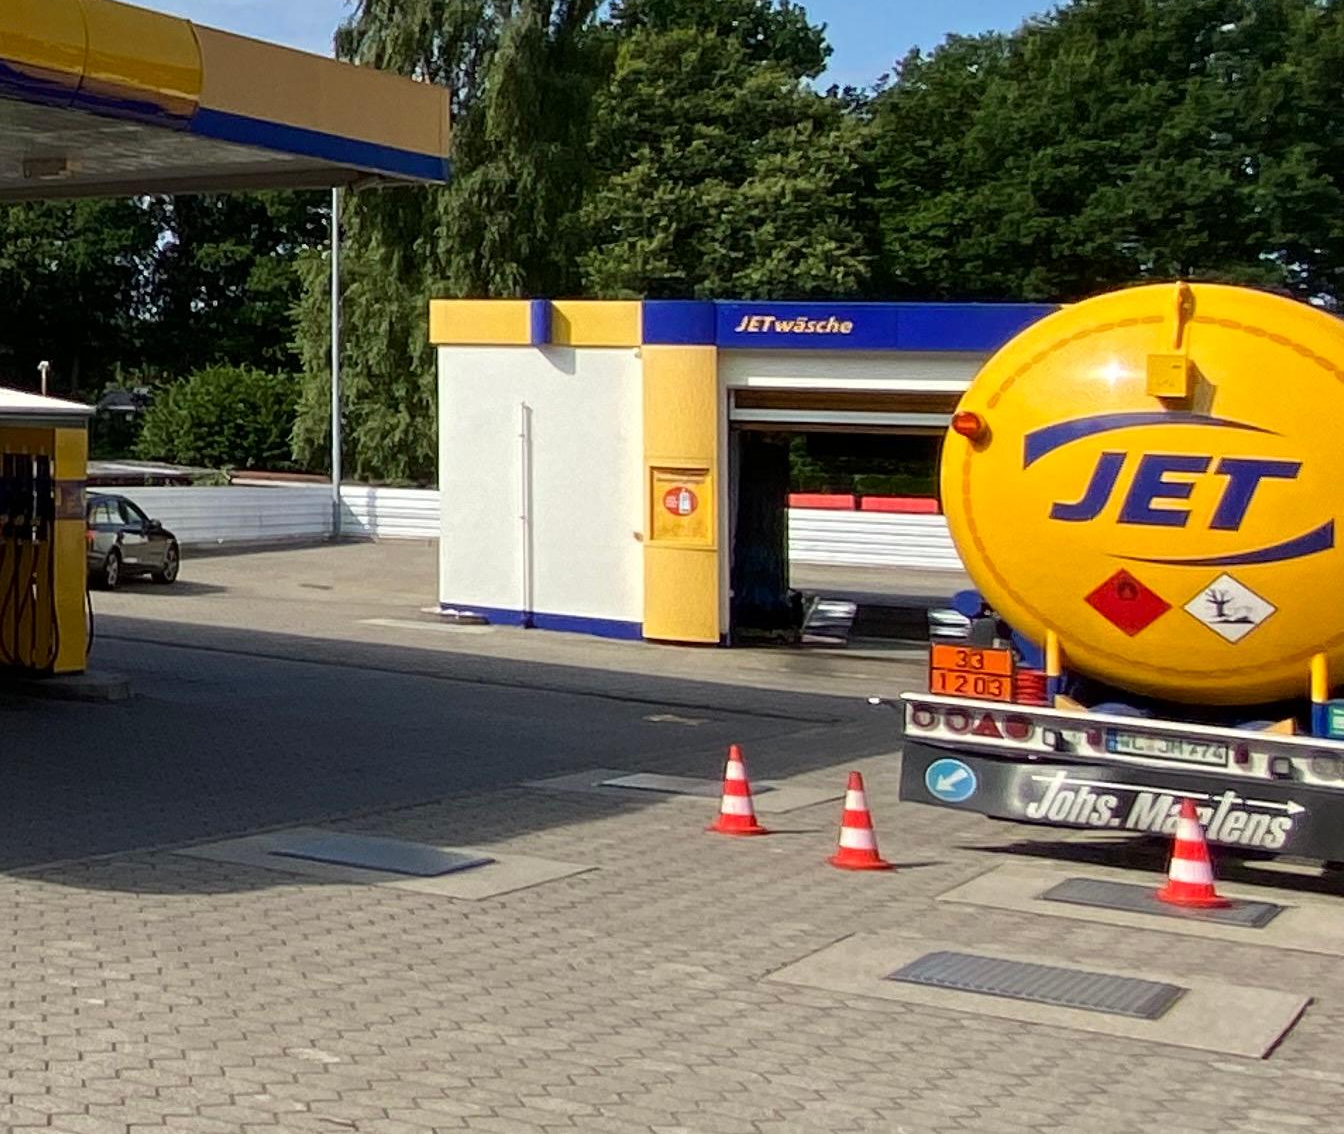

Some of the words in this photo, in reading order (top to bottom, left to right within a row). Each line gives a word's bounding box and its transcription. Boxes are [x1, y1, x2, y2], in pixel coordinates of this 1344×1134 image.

[1049, 451, 1303, 532] JET
[955, 650, 984, 670] 33
[940, 672, 1003, 697] 1203
[1026, 771, 1121, 827] Johs.
